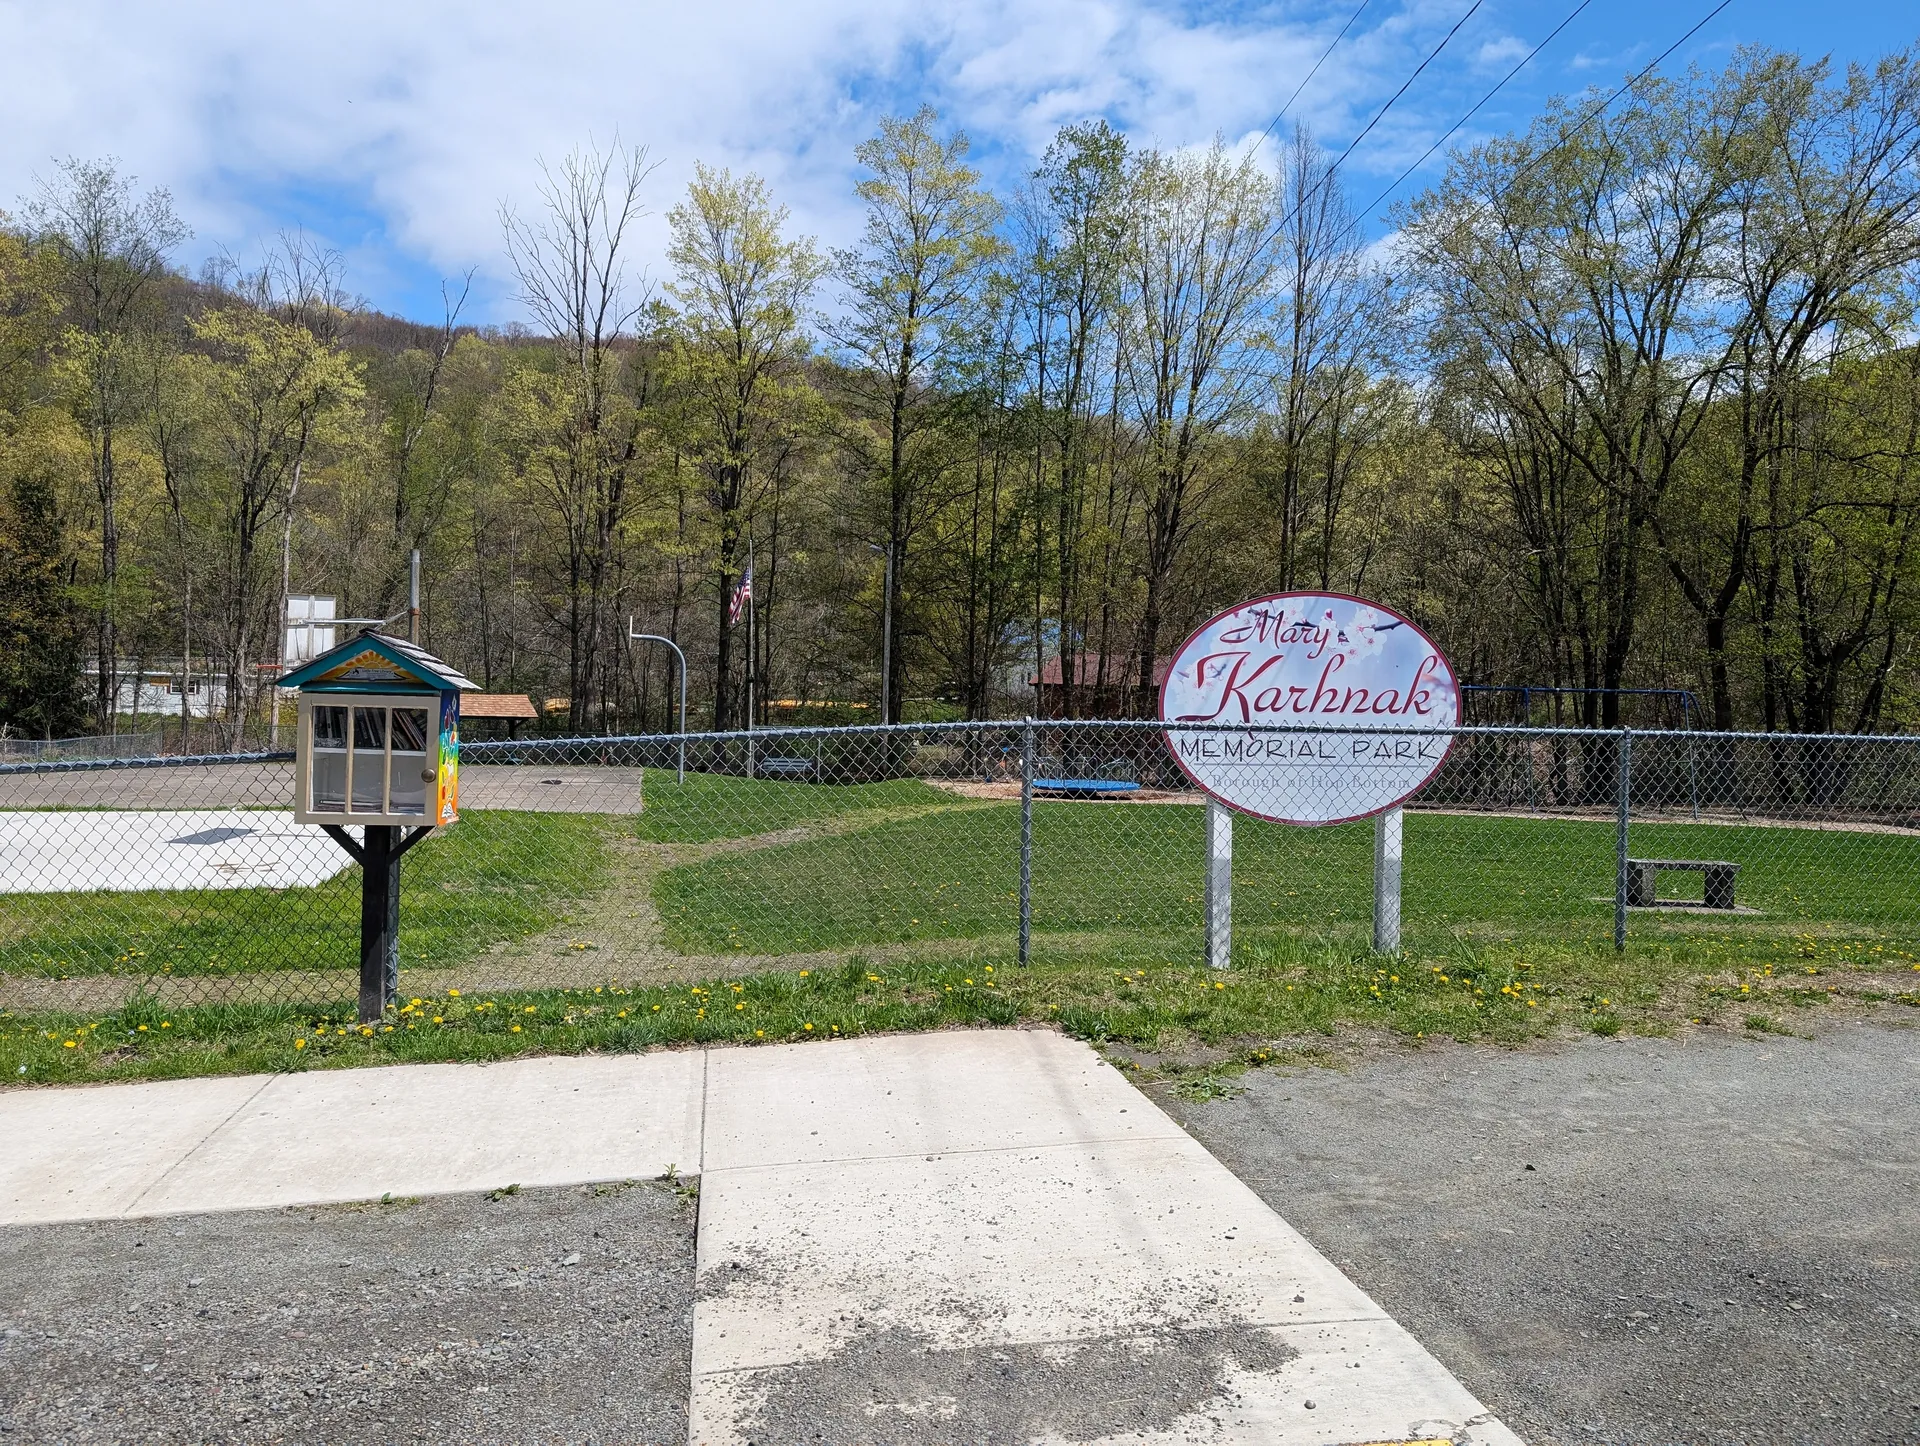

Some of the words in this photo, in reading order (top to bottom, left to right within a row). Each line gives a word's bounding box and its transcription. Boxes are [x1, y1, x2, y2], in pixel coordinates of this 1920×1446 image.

[1220, 609, 1330, 659] Mary
[1175, 651, 1438, 740] Karhnak
[1181, 738, 1336, 762] MEMORIAL
[1353, 737, 1438, 760] PARK
[1213, 774, 1280, 791] Borough
[1287, 774, 1304, 787] of
[1311, 774, 1344, 791] Hop
[1352, 775, 1411, 788] Bottom
